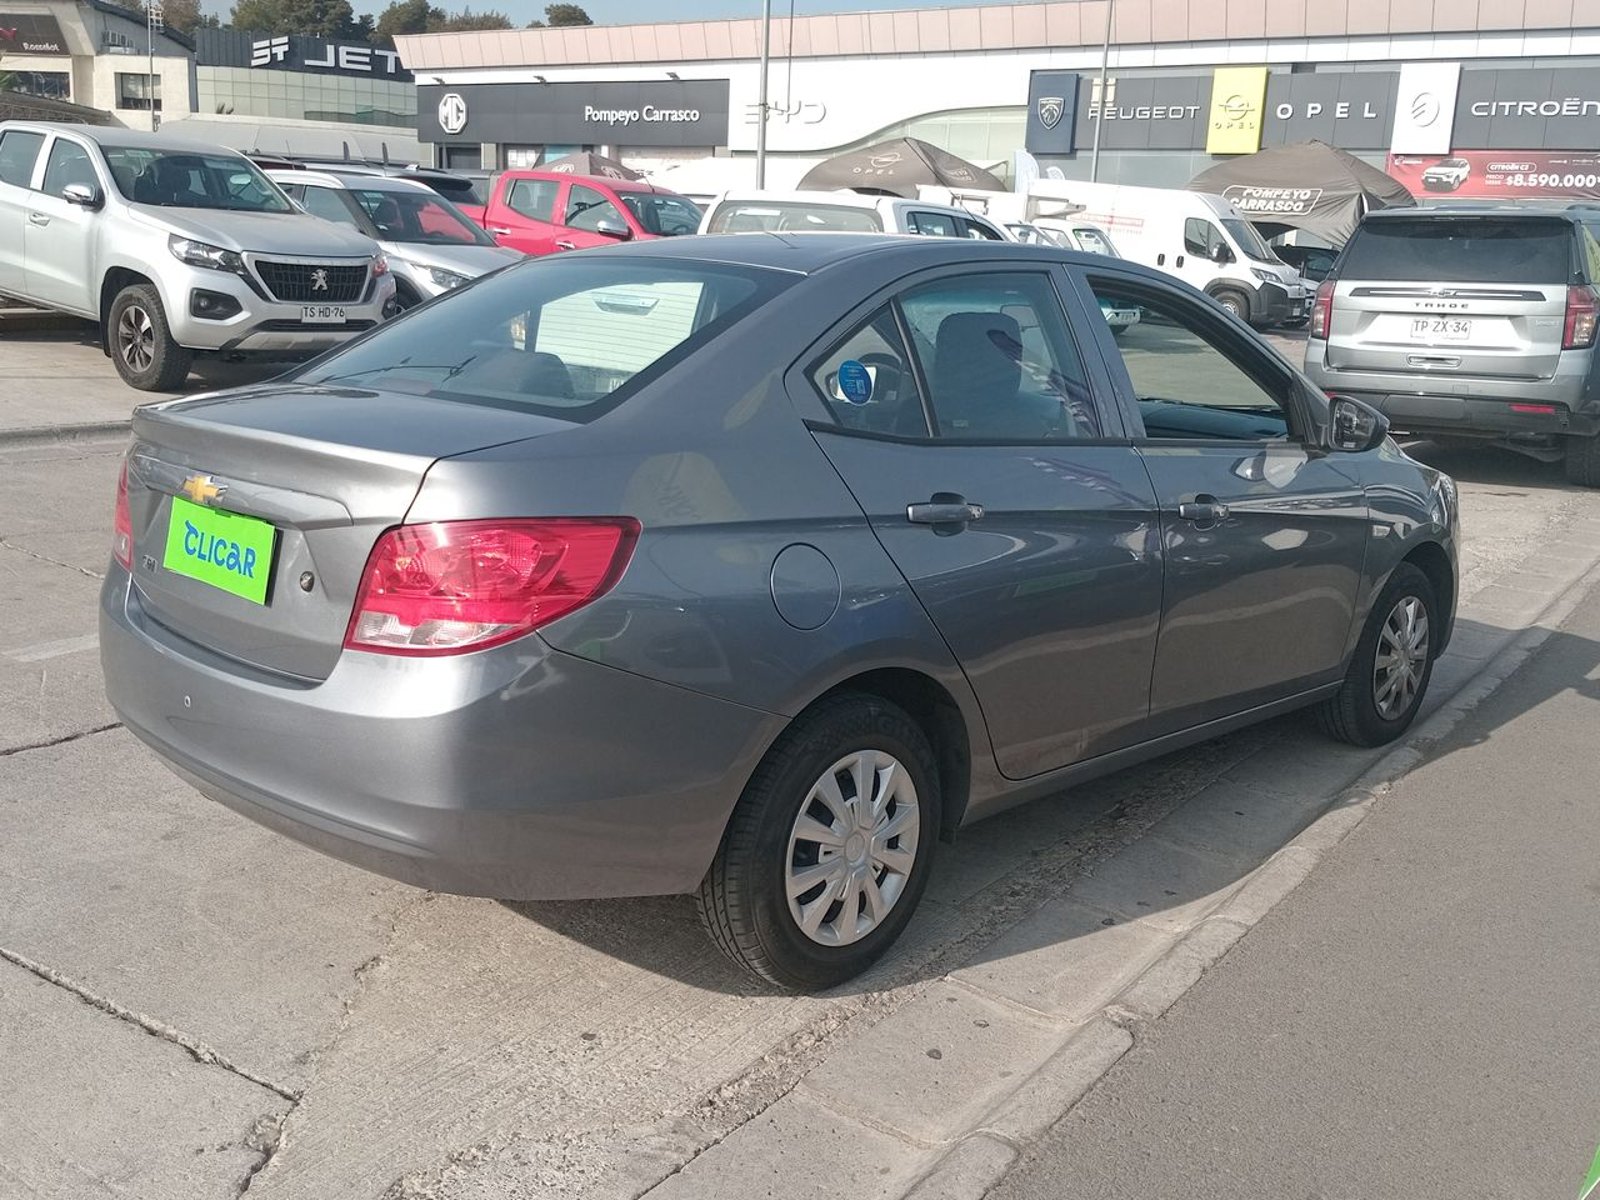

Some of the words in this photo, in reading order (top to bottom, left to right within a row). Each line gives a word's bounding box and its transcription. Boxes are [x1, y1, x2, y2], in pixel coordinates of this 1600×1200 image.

[585, 105, 640, 126] Pompeyo
[642, 105, 700, 121] Carrasco
[1275, 102, 1377, 119] OPEL
[1215, 122, 1255, 130] OPEL
[853, 167, 894, 175] OPEL
[1242, 189, 1311, 200] POMPEYO
[1230, 197, 1304, 211] CARRASCO
